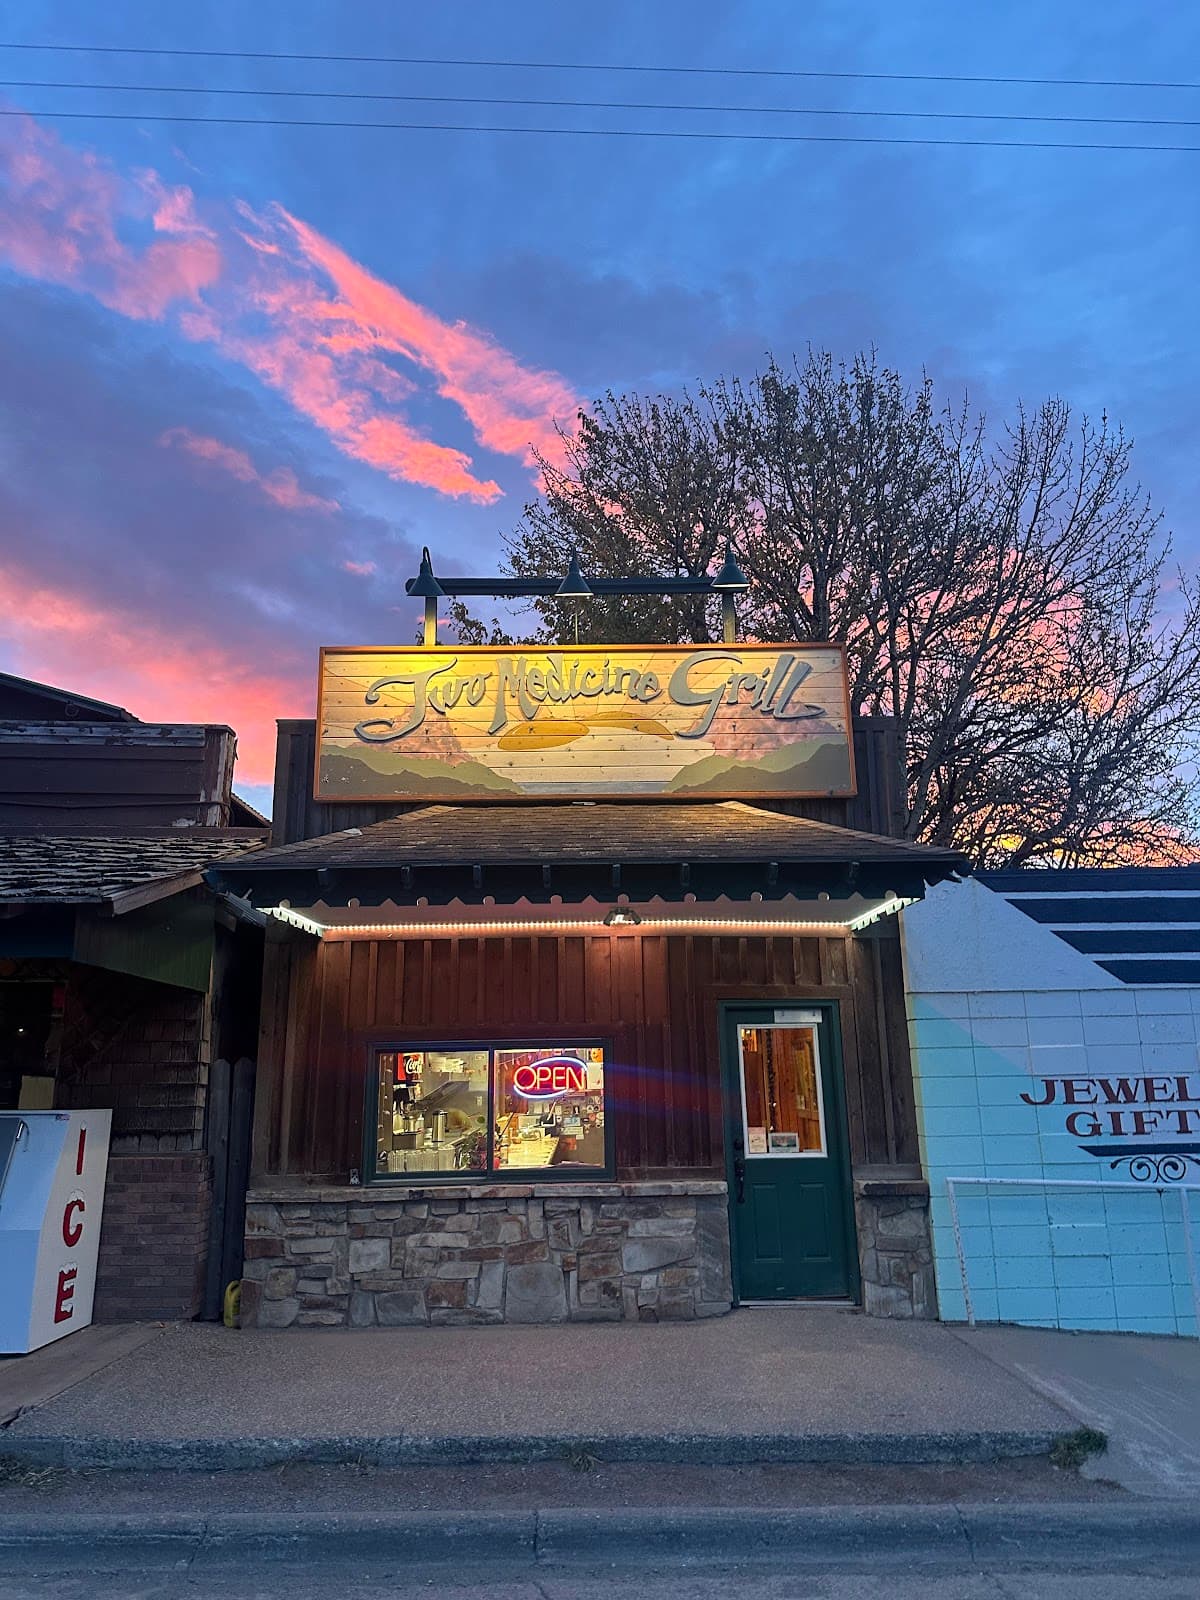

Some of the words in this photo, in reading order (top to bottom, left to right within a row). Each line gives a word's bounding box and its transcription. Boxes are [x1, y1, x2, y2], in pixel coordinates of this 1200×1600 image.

[354, 657, 490, 741] Two
[488, 654, 662, 734] Medicine
[667, 650, 826, 738] Grill
[513, 1065, 586, 1090] OPEN
[1065, 1109, 1200, 1138] GIFT
[54, 1121, 87, 1324] ICE
